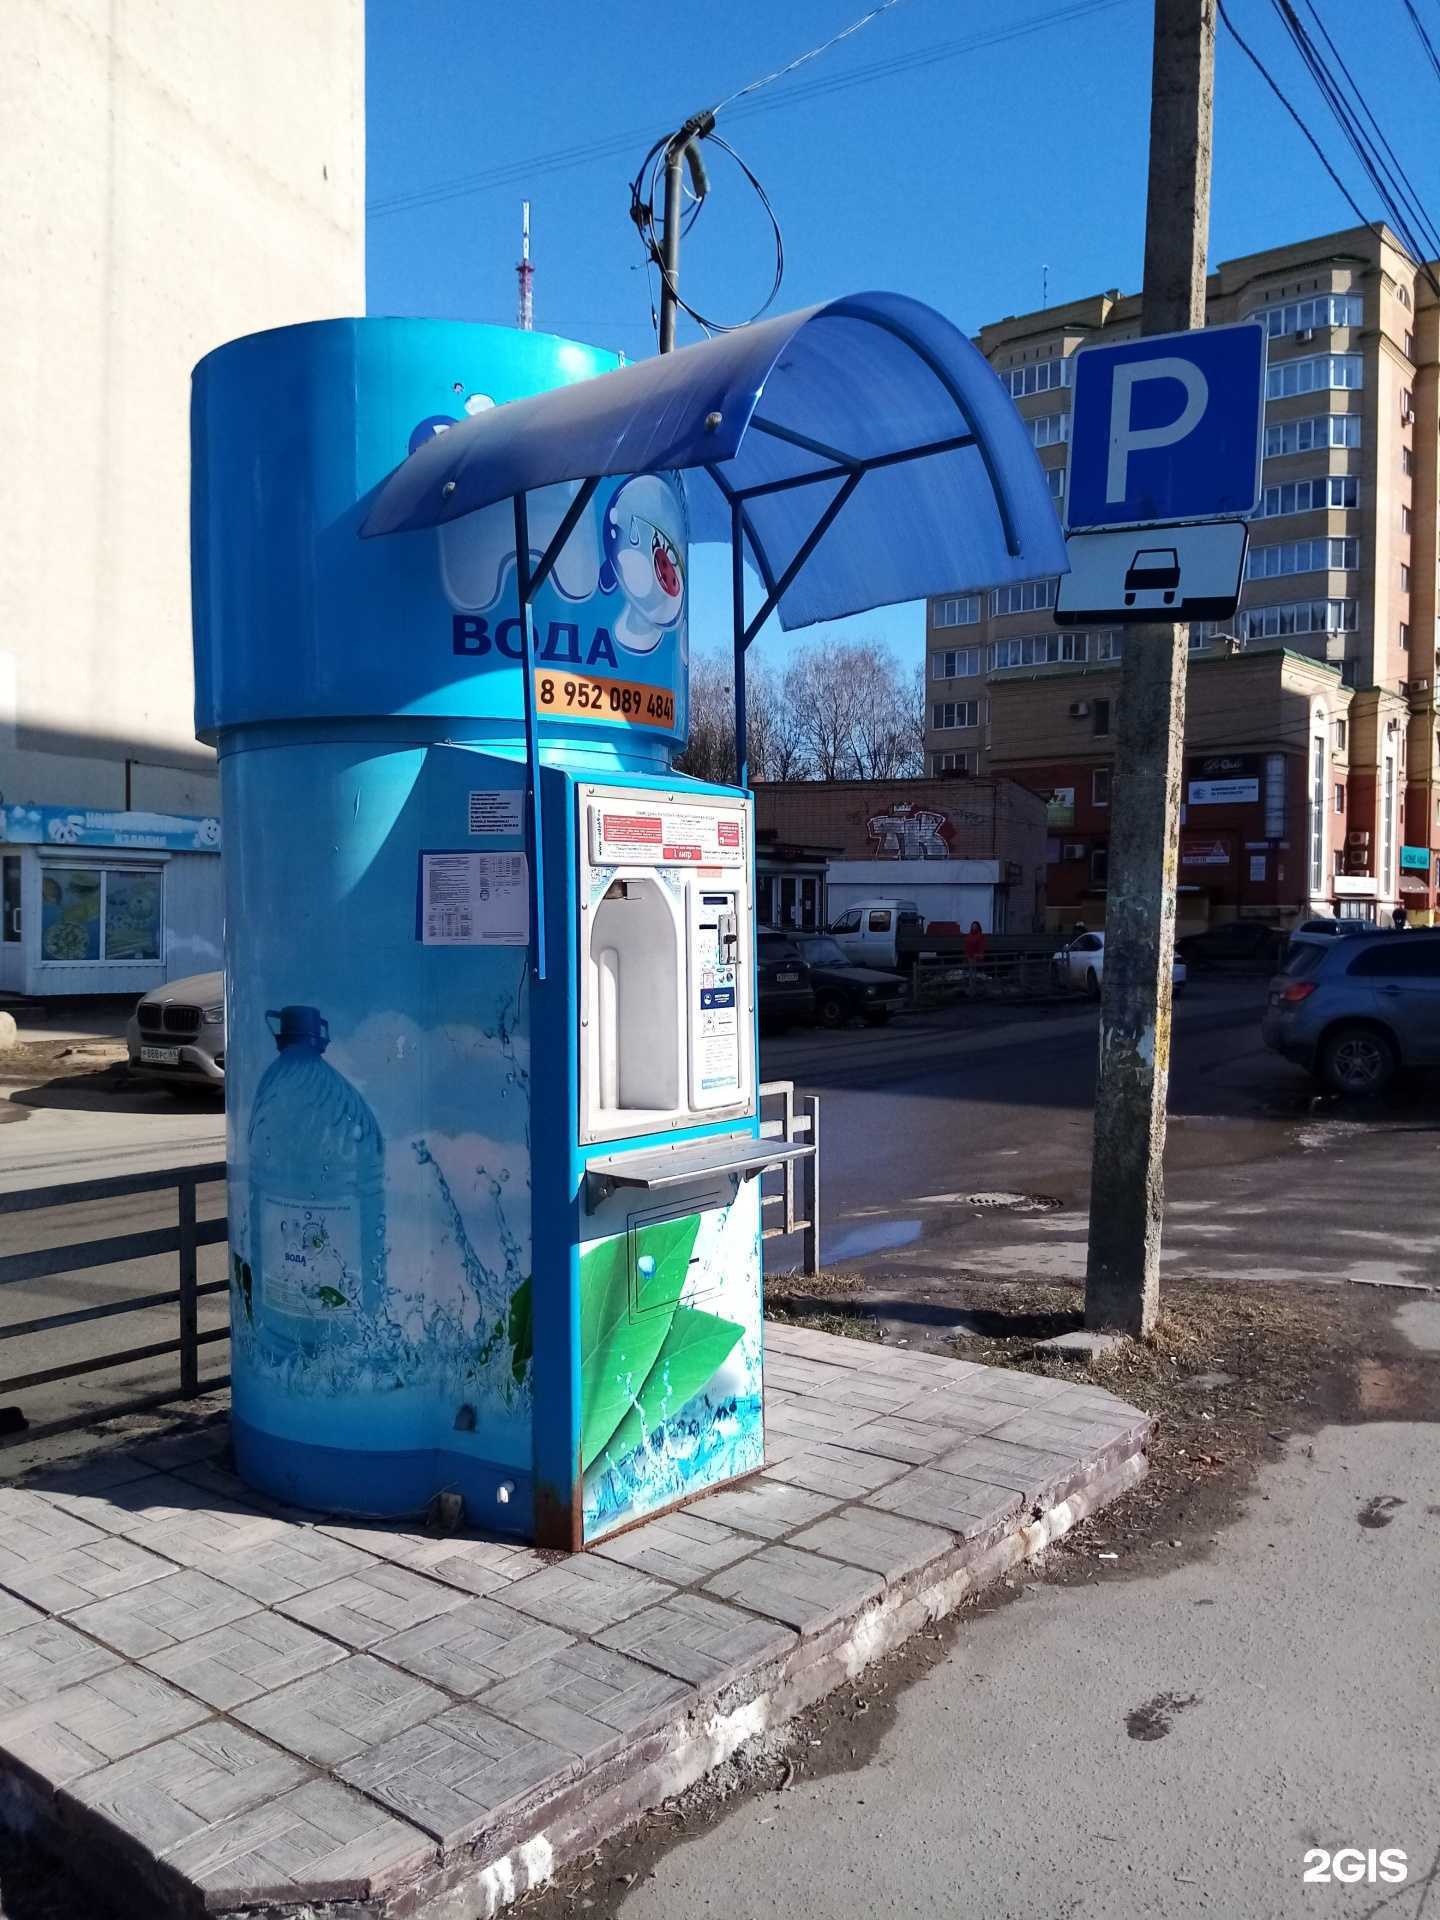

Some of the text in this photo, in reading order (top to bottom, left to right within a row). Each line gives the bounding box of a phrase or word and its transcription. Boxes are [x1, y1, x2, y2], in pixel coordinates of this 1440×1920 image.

[1105, 356, 1209, 504] P
[451, 614, 619, 669] ВОДА
[540, 679, 674, 721] 8 952 089 4841
